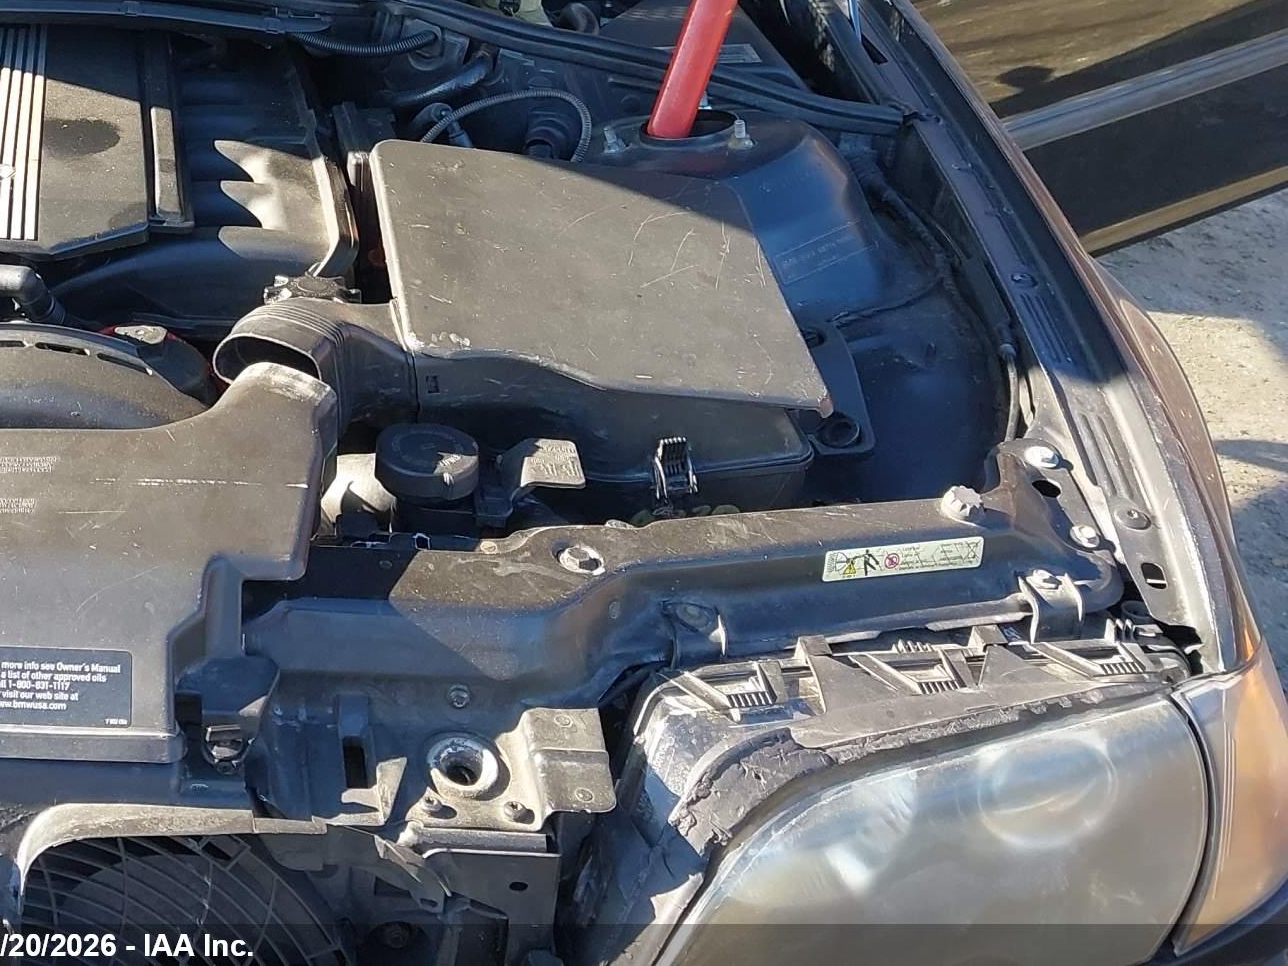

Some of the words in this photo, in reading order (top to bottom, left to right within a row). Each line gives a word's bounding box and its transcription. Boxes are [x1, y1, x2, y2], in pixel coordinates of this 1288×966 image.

[1, 661, 23, 670] more
[24, 661, 39, 670] info
[40, 662, 55, 671] see
[91, 664, 121, 674] Manual
[7, 670, 20, 679] list
[21, 670, 30, 679] of
[31, 671, 52, 680] other
[53, 672, 91, 683] approved
[91, 673, 107, 682] oils
[8, 681, 71, 691] 1-800-831-1117
[2, 690, 19, 699] visit
[35, 691, 53, 700] web
[54, 692, 69, 701] site
[70, 693, 79, 701] at
